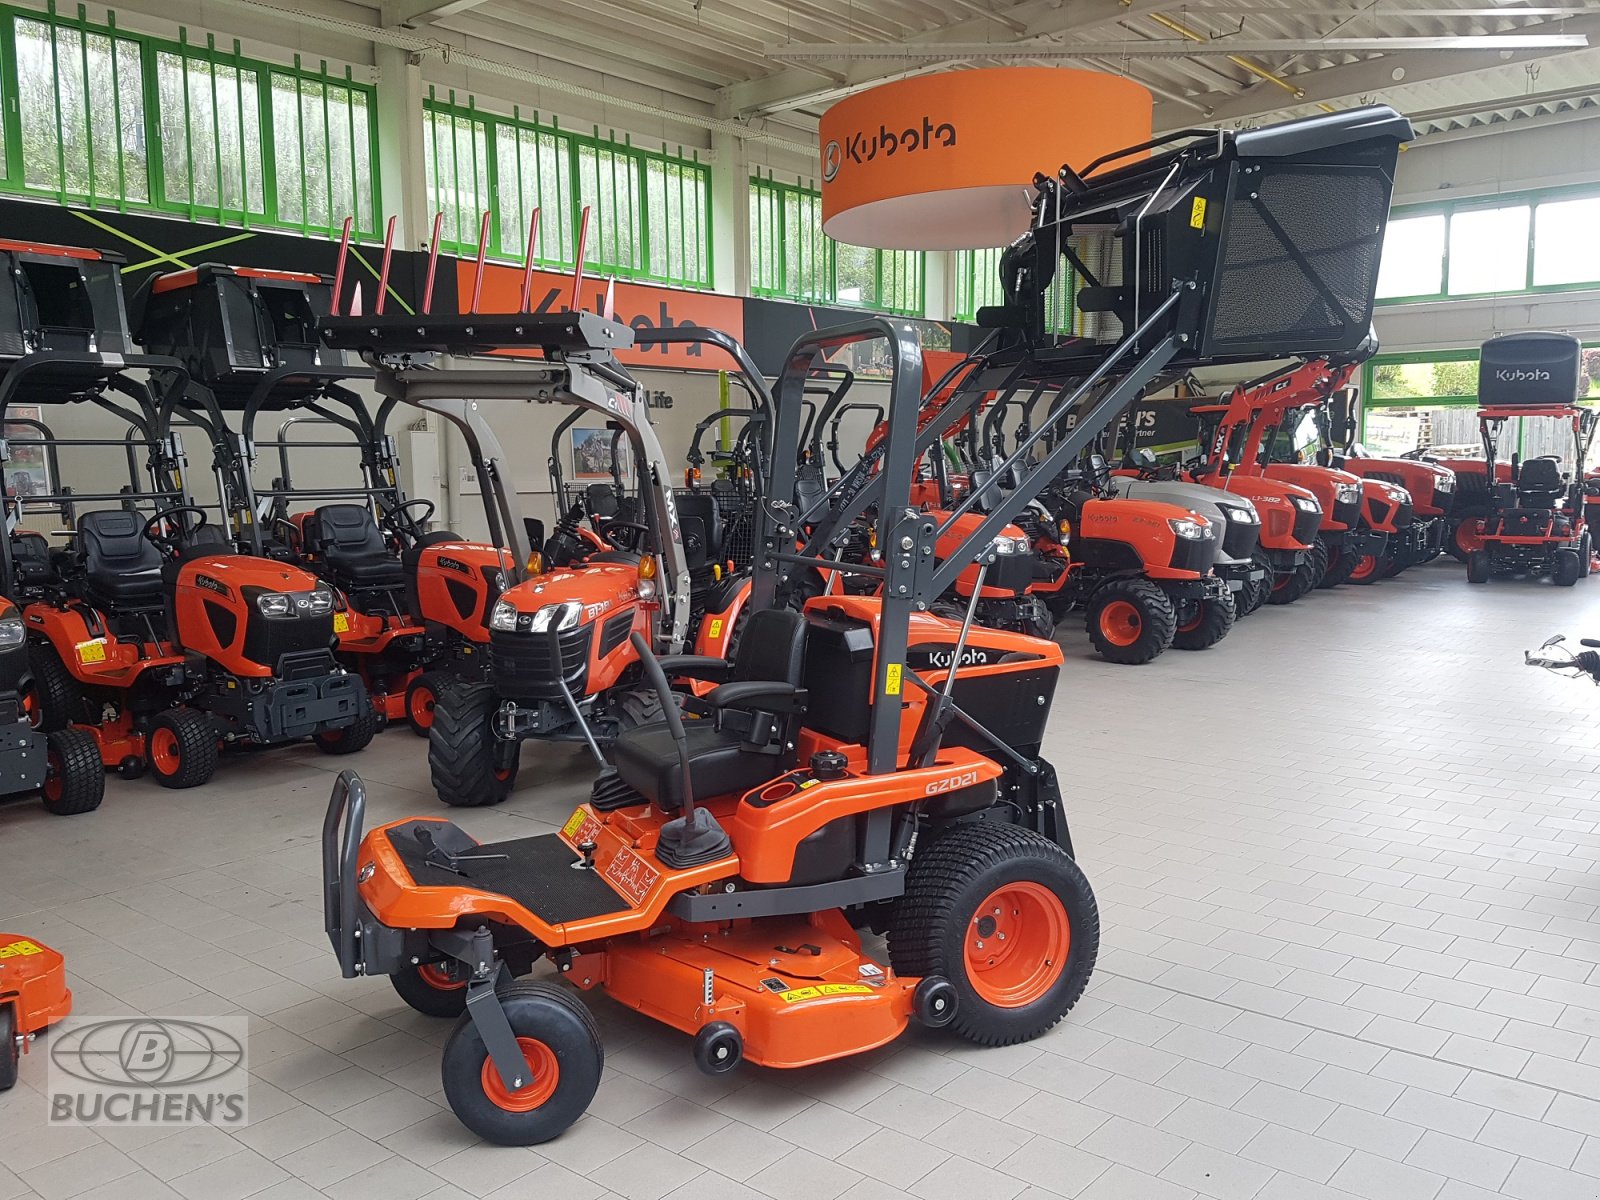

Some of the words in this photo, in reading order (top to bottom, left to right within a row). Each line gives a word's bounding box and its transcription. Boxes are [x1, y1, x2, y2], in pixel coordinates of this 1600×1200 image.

[846, 116, 956, 164] Kubota
[520, 284, 702, 357] Kota
[1496, 368, 1550, 381] Kubota
[1214, 433, 1225, 453] MX
[665, 489, 678, 529] MX
[925, 771, 978, 795] GZD21
